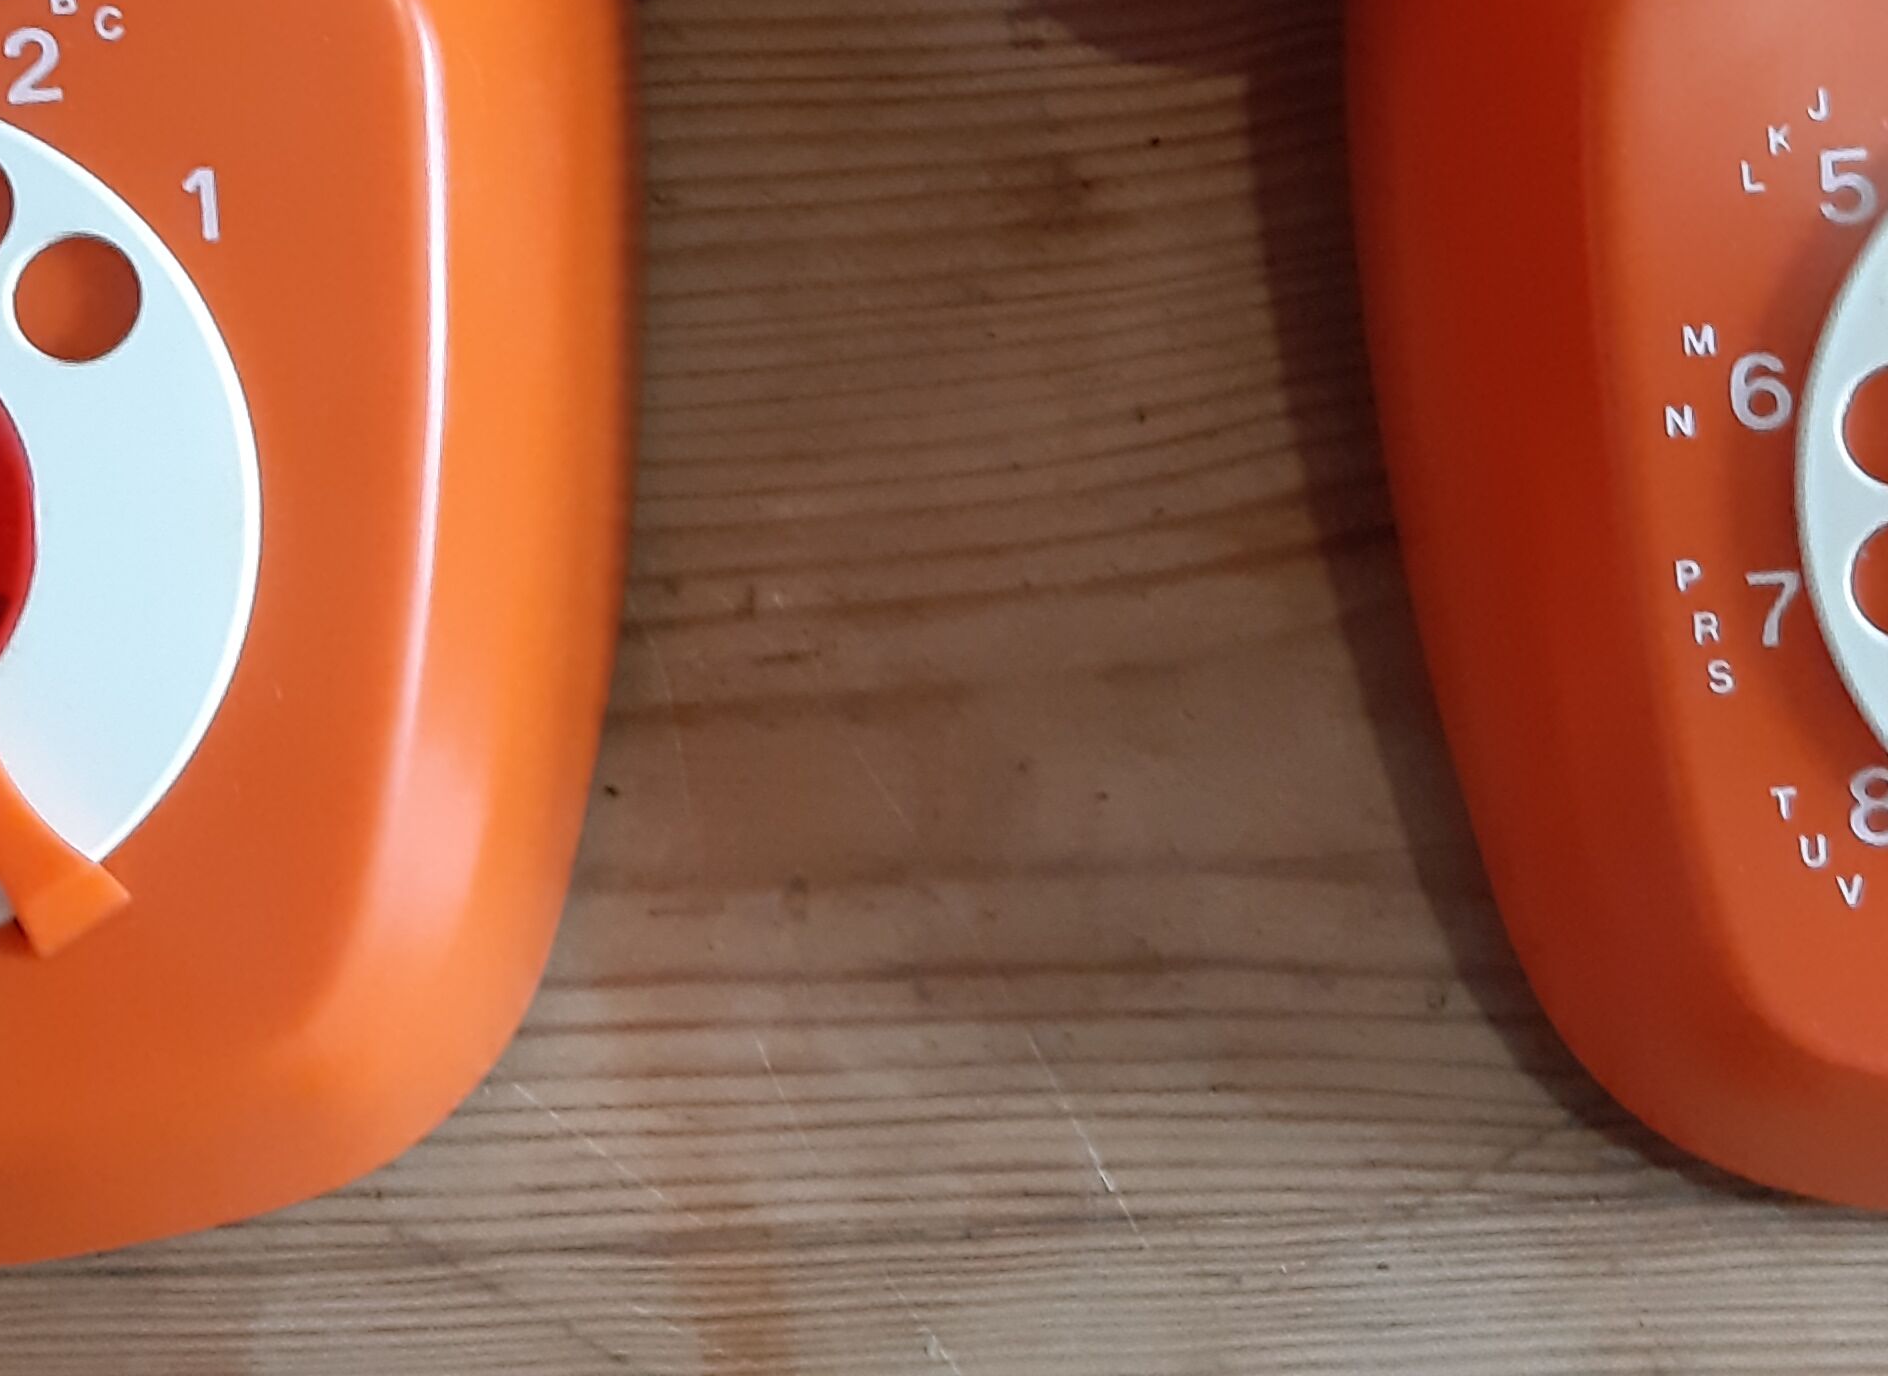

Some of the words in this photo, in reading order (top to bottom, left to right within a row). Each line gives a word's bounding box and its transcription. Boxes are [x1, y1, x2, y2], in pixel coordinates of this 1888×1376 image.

[3, 27, 64, 105] 2
[182, 167, 220, 242] 1
[1819, 147, 1874, 222] 5
[1730, 352, 1793, 431] 6
[1745, 570, 1801, 647] 7
